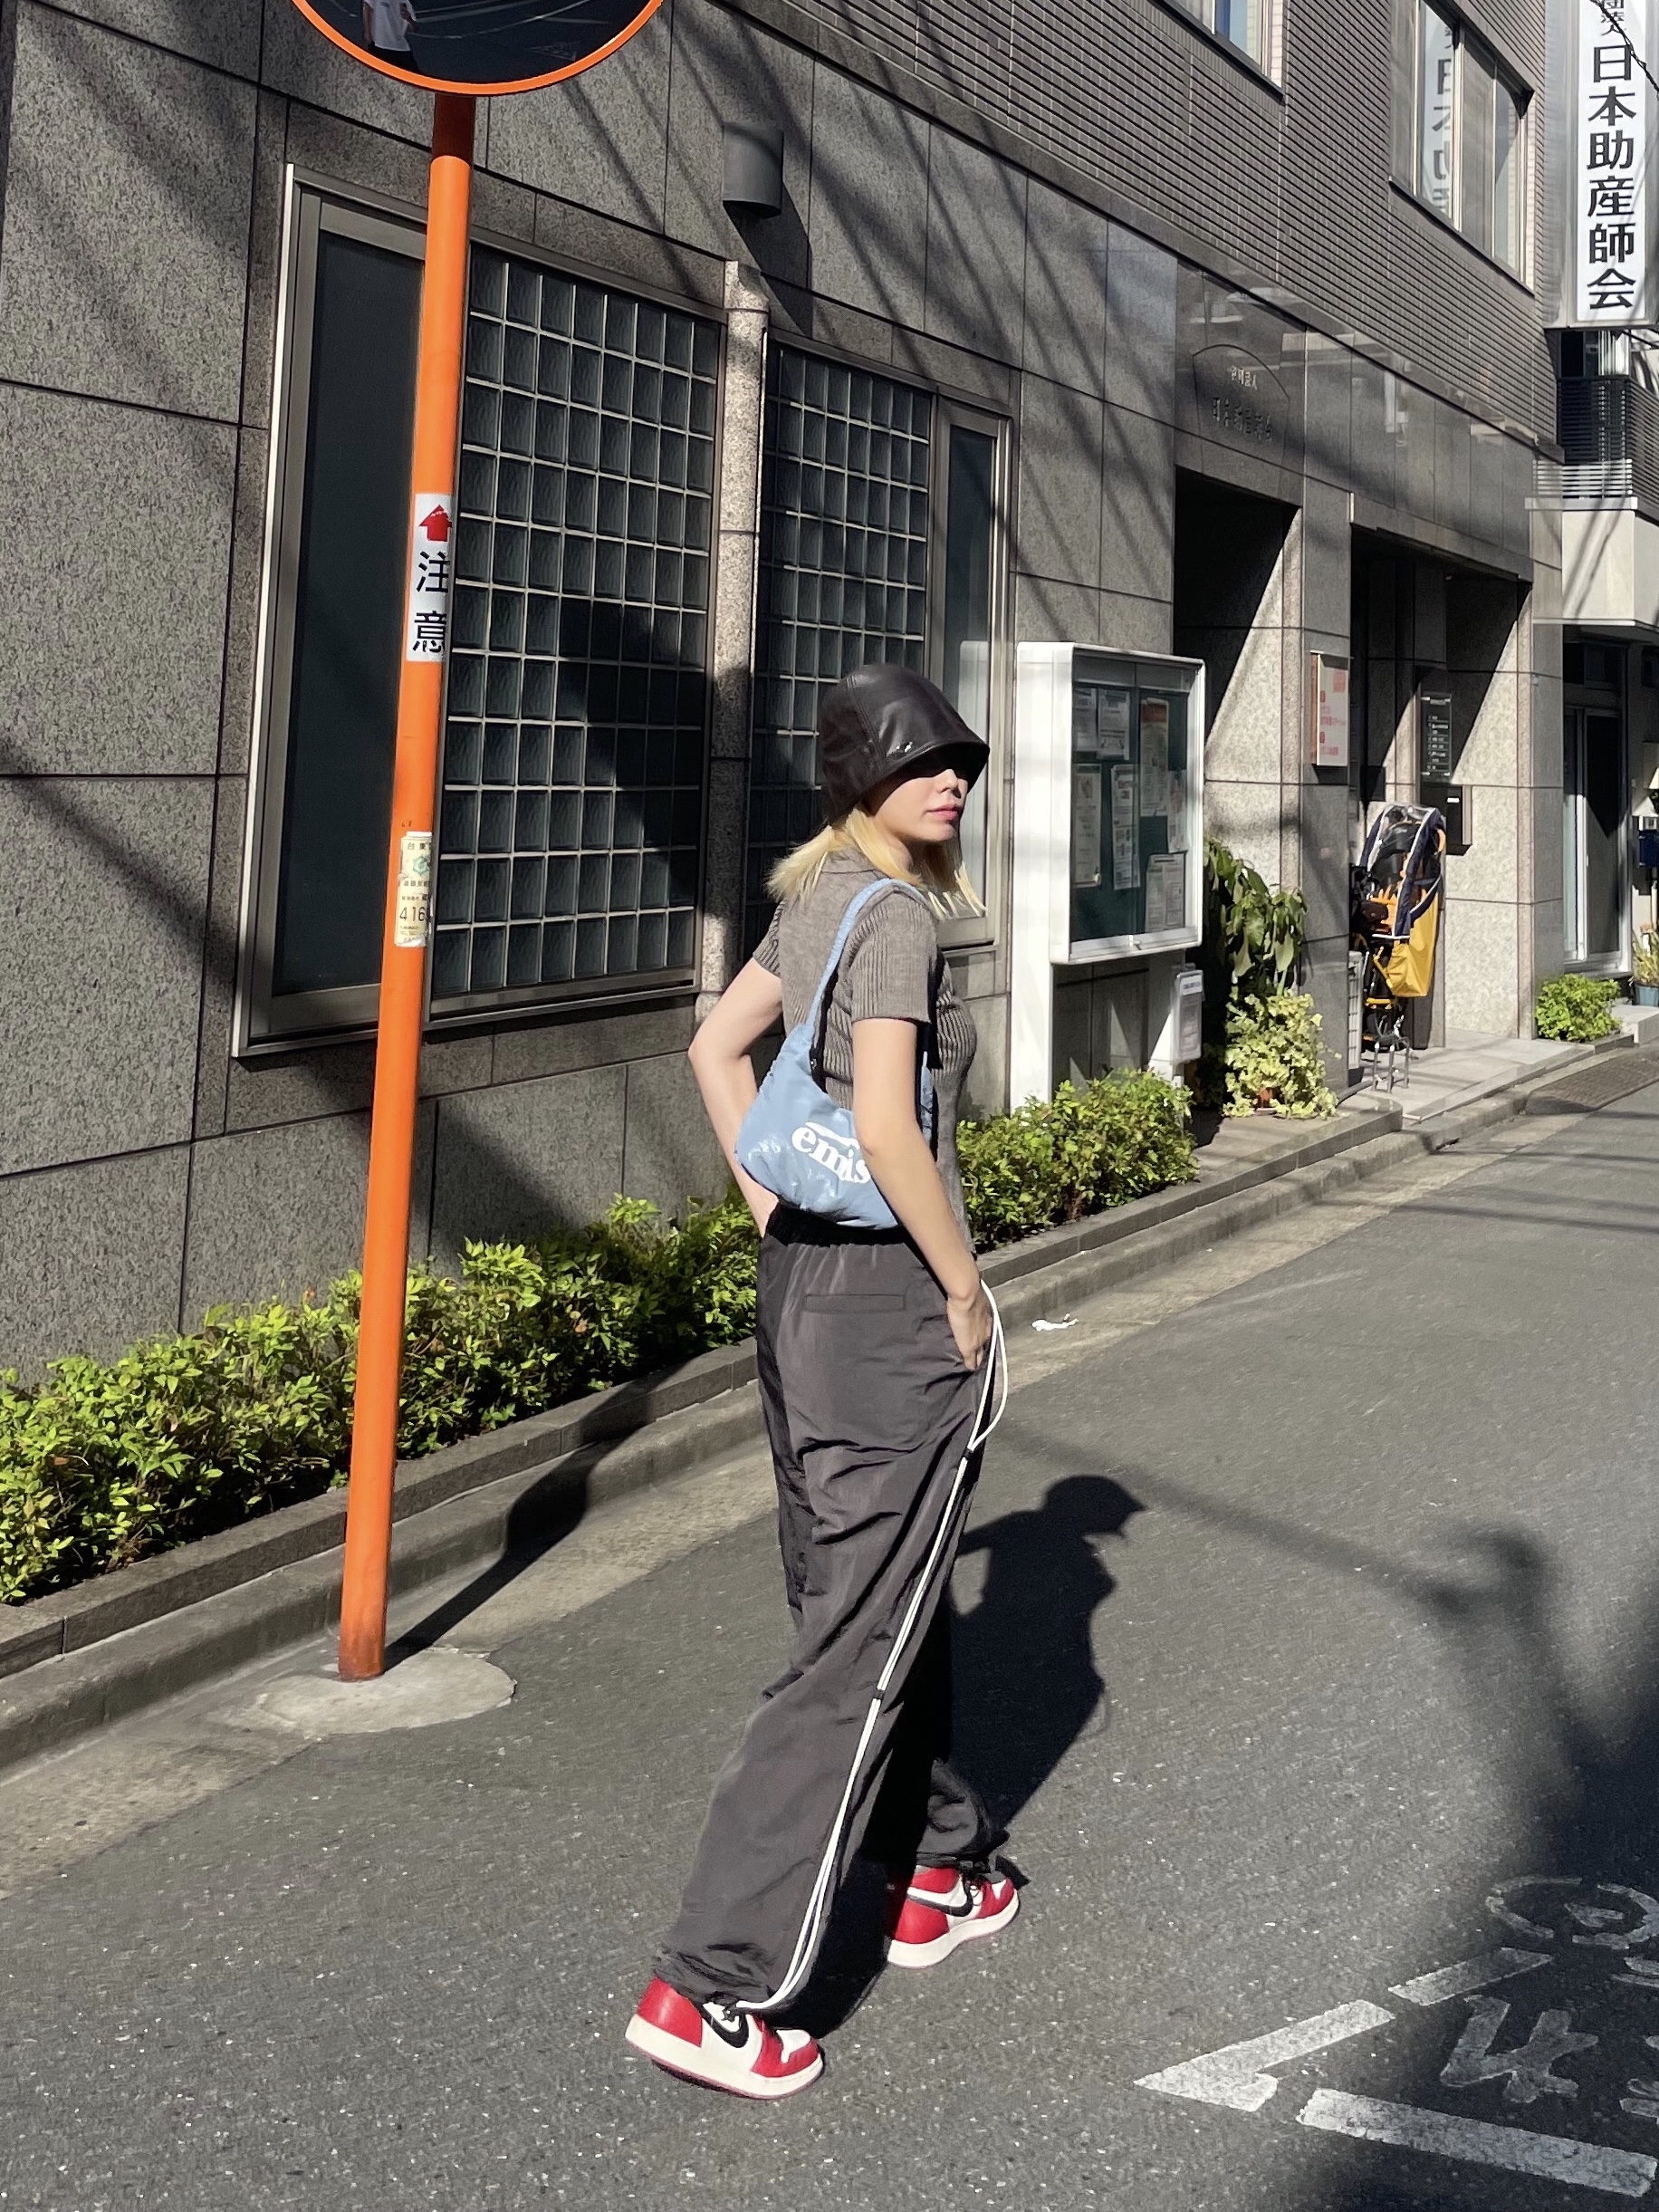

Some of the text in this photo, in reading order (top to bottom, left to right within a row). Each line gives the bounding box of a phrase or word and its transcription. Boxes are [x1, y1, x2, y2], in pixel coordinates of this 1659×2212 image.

[1587, 45, 1636, 310] 日本助産師会
[412, 551, 450, 652] 注意
[399, 906, 426, 922] 416
[791, 1126, 872, 1184] emis
